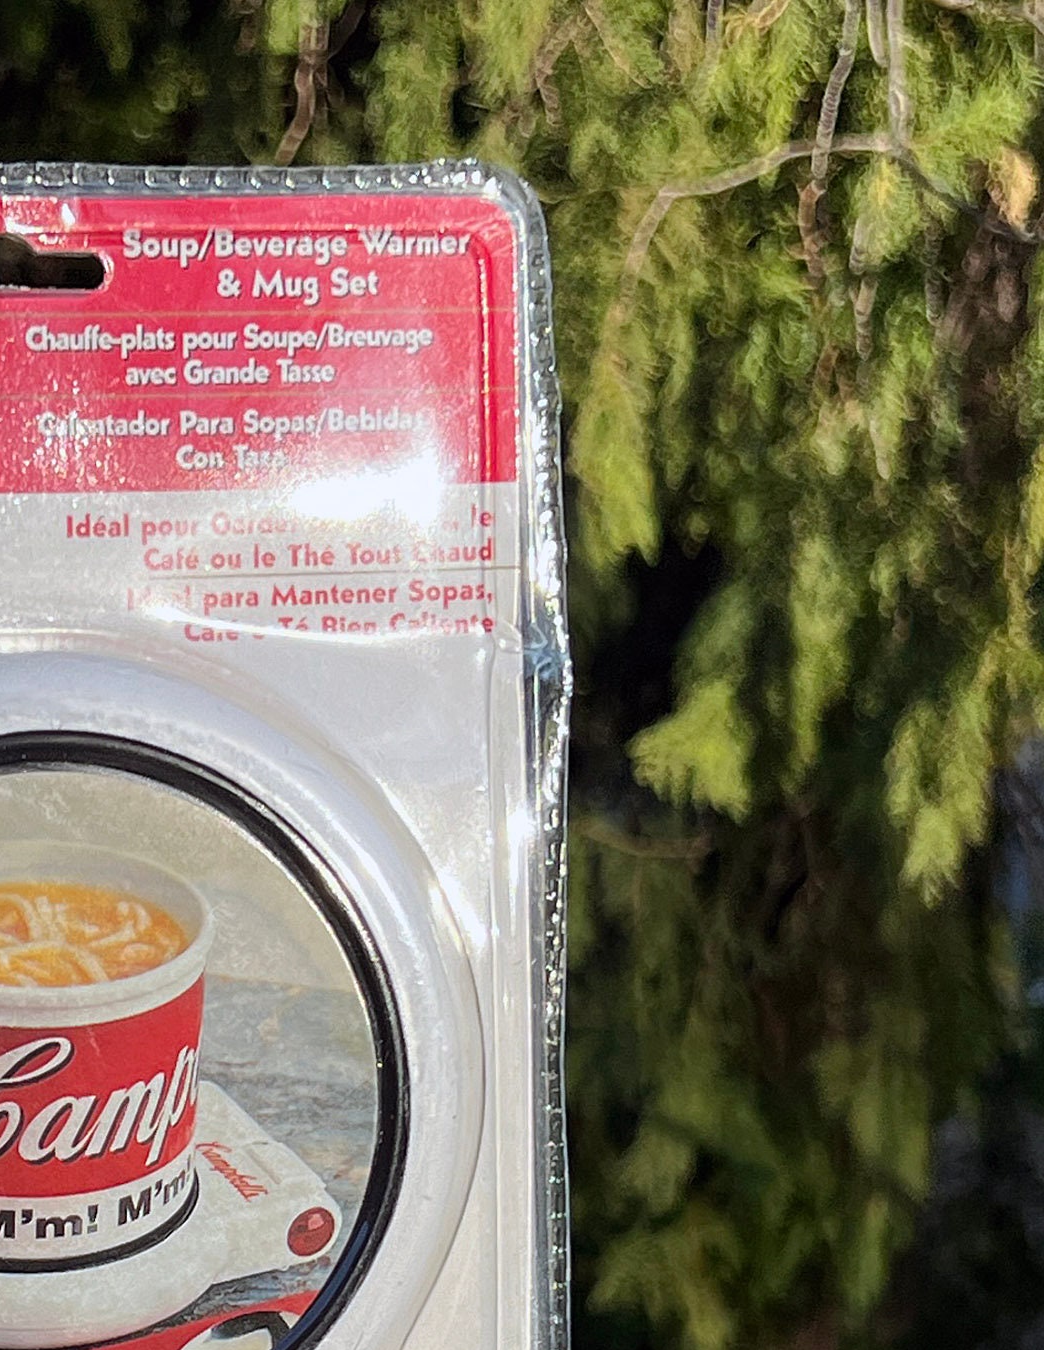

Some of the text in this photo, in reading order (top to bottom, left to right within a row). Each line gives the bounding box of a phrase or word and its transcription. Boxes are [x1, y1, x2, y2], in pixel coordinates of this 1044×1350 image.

[122, 227, 471, 267] Soup/Beverage Warmer
[217, 266, 380, 306] & Mug Set
[25, 322, 434, 358] Chauffe-plats pour Soupe/Breuvage
[125, 358, 336, 386] avec Grande Tasse
[179, 410, 235, 436] Para
[175, 444, 225, 470] Con
[66, 512, 130, 539] Idéal
[141, 520, 198, 546] pour
[470, 503, 492, 528] le
[143, 547, 200, 571] Café
[210, 551, 242, 570] ou
[253, 543, 276, 569] le
[289, 542, 336, 567] Thé
[204, 590, 260, 616] para
[271, 583, 398, 607] Mantener
[408, 578, 493, 610] Sopas,
